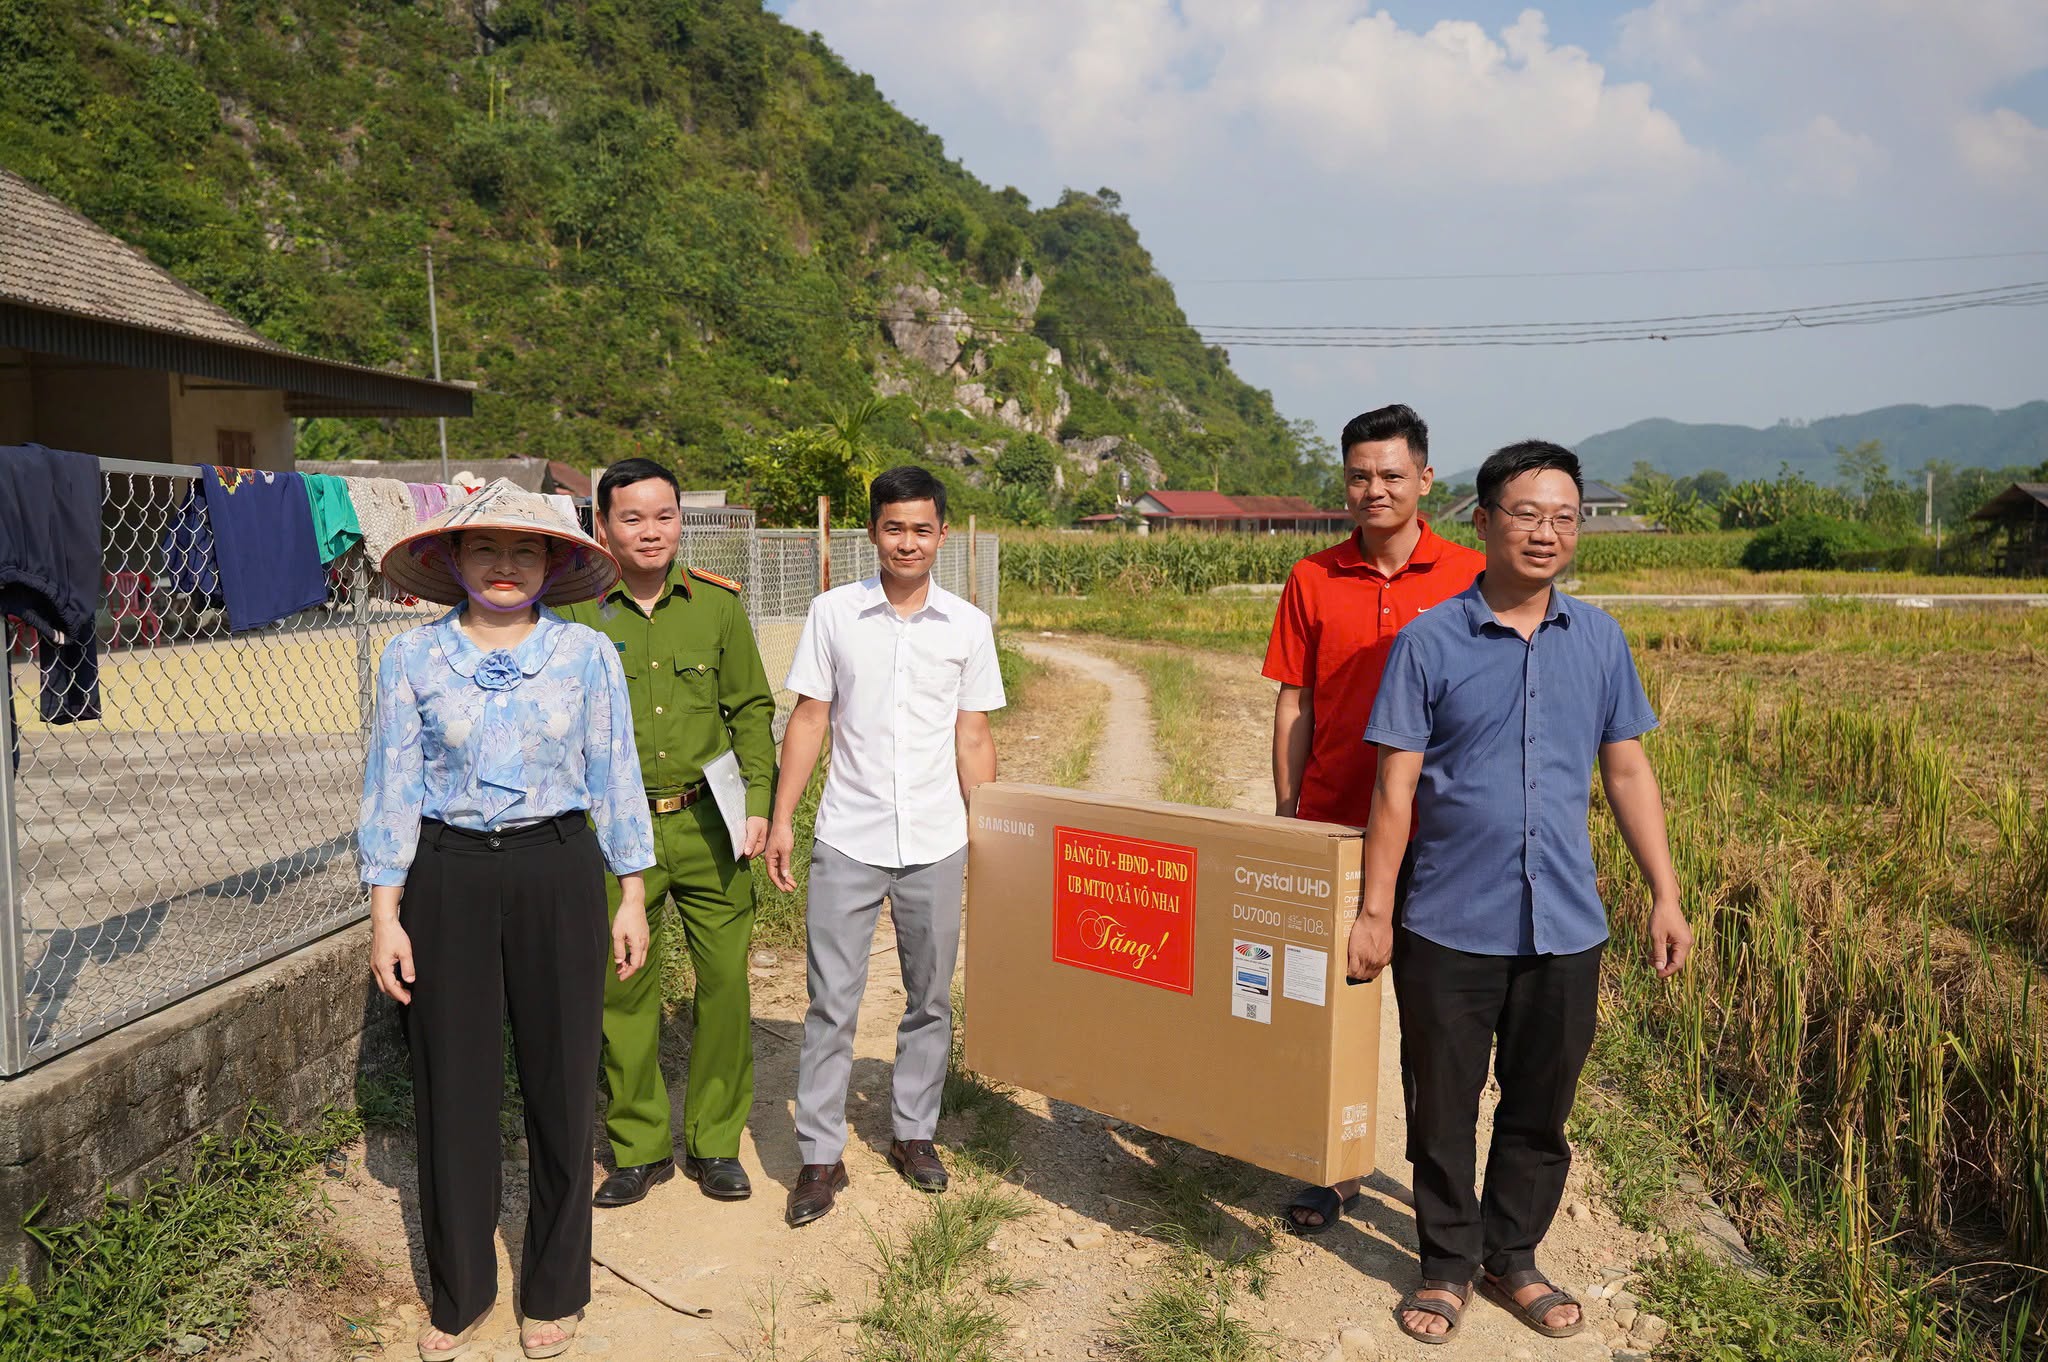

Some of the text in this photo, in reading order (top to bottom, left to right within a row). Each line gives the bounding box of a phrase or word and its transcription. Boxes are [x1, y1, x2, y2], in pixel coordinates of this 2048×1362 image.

[978, 815, 1035, 837] SAMSUNG
[1064, 840, 1094, 865] ĐẢNG
[1096, 844, 1111, 868] ỦY
[1118, 853, 1148, 875] HĐND
[1157, 860, 1188, 882] UBND
[1068, 875, 1180, 914] UB MTTQ XÃ VÕ NHAI
[1234, 866, 1331, 898] Crystal UHD
[1233, 904, 1281, 927] DU7000
[1303, 916, 1324, 936] 108
[1076, 908, 1170, 970] Tặng!
